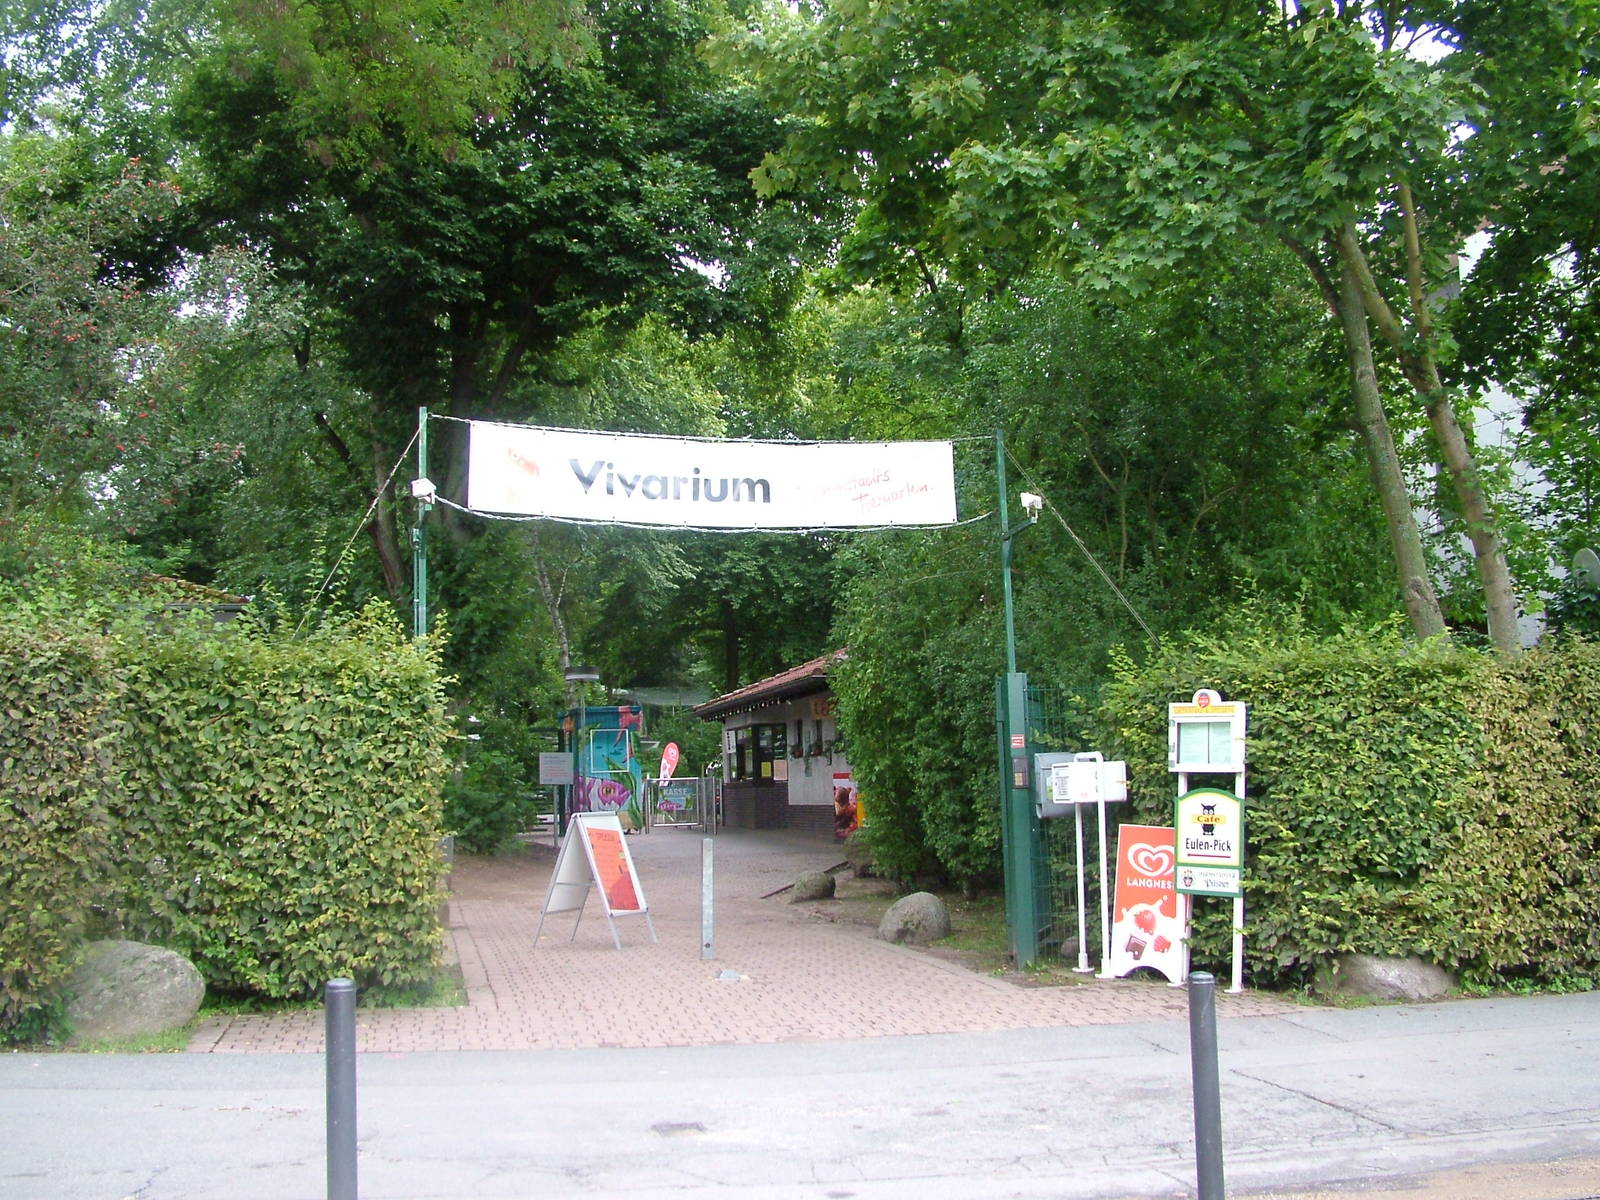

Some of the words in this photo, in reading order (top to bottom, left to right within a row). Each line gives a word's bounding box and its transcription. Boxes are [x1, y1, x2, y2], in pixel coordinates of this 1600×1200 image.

[568, 458, 771, 503] Vivarium
[663, 788, 688, 796] KASSE
[1185, 837, 1232, 852] Eulen-Pick
[1126, 876, 1174, 890] LANGNES
